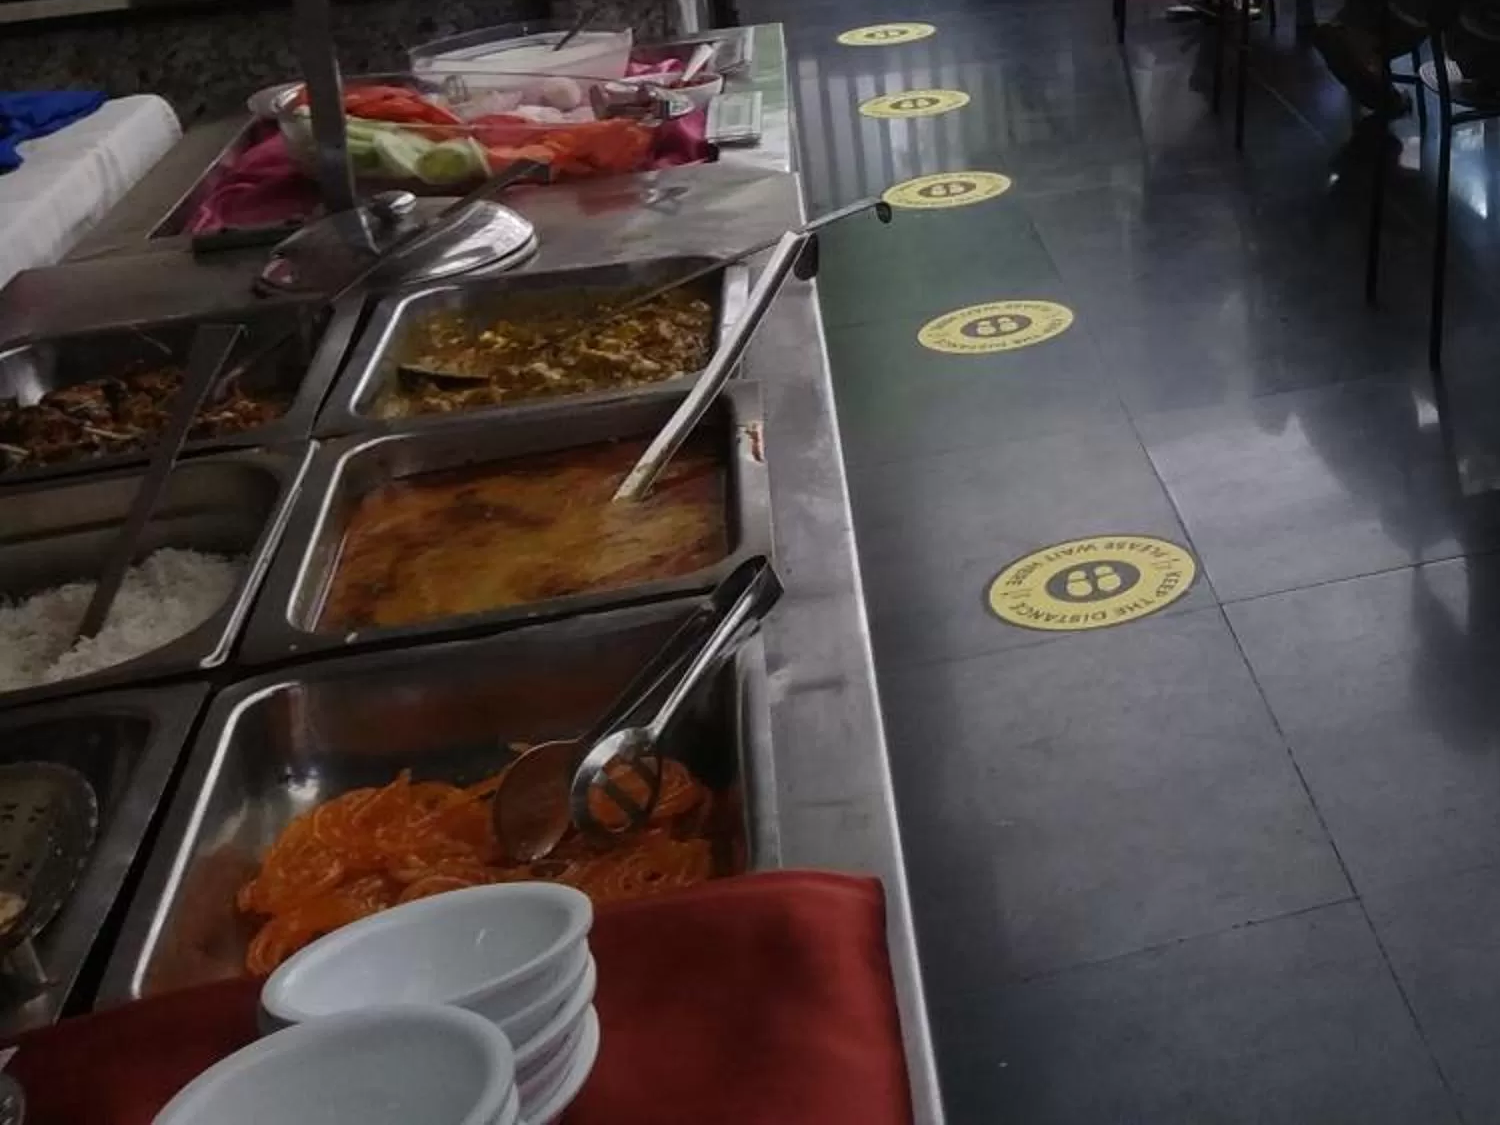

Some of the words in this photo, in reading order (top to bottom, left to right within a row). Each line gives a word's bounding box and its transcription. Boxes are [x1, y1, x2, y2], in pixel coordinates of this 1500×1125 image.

[1044, 543, 1098, 562] WAIT
[1103, 541, 1169, 558] PLEASE
[1004, 561, 1043, 587] HERE
[1156, 570, 1182, 599] KEEP
[1008, 602, 1108, 624] DISTANCE
[1113, 597, 1154, 617] THE
